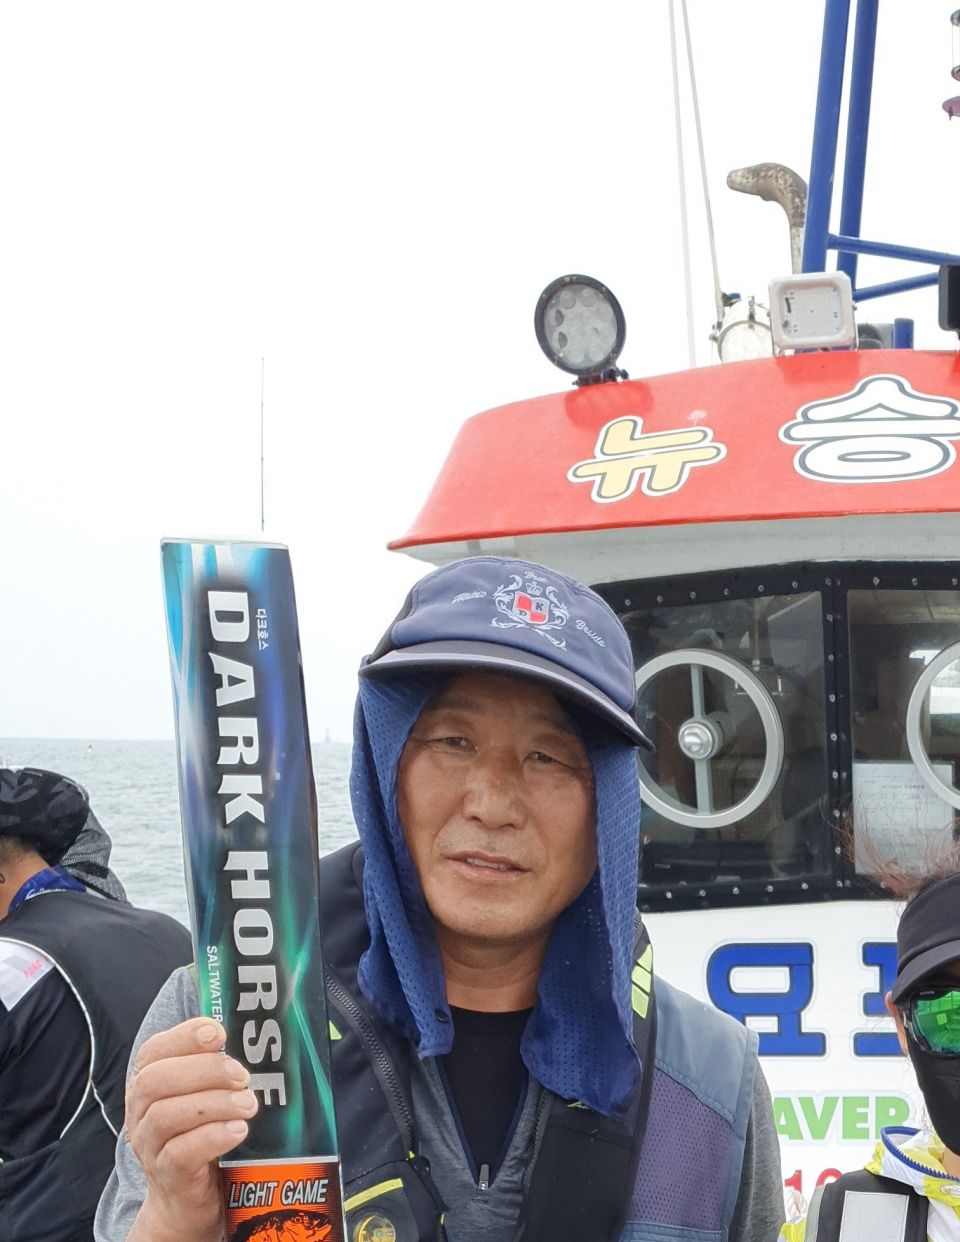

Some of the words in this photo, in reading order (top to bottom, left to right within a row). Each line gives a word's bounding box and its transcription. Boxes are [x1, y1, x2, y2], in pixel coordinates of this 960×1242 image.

[568, 415, 727, 503] 뉴
[207, 590, 265, 825] DARK
[206, 945, 224, 1023] SALTWATER
[223, 851, 287, 1106] HORSE
[228, 1181, 279, 1209] LIGHT
[281, 1179, 329, 1204] GAME
